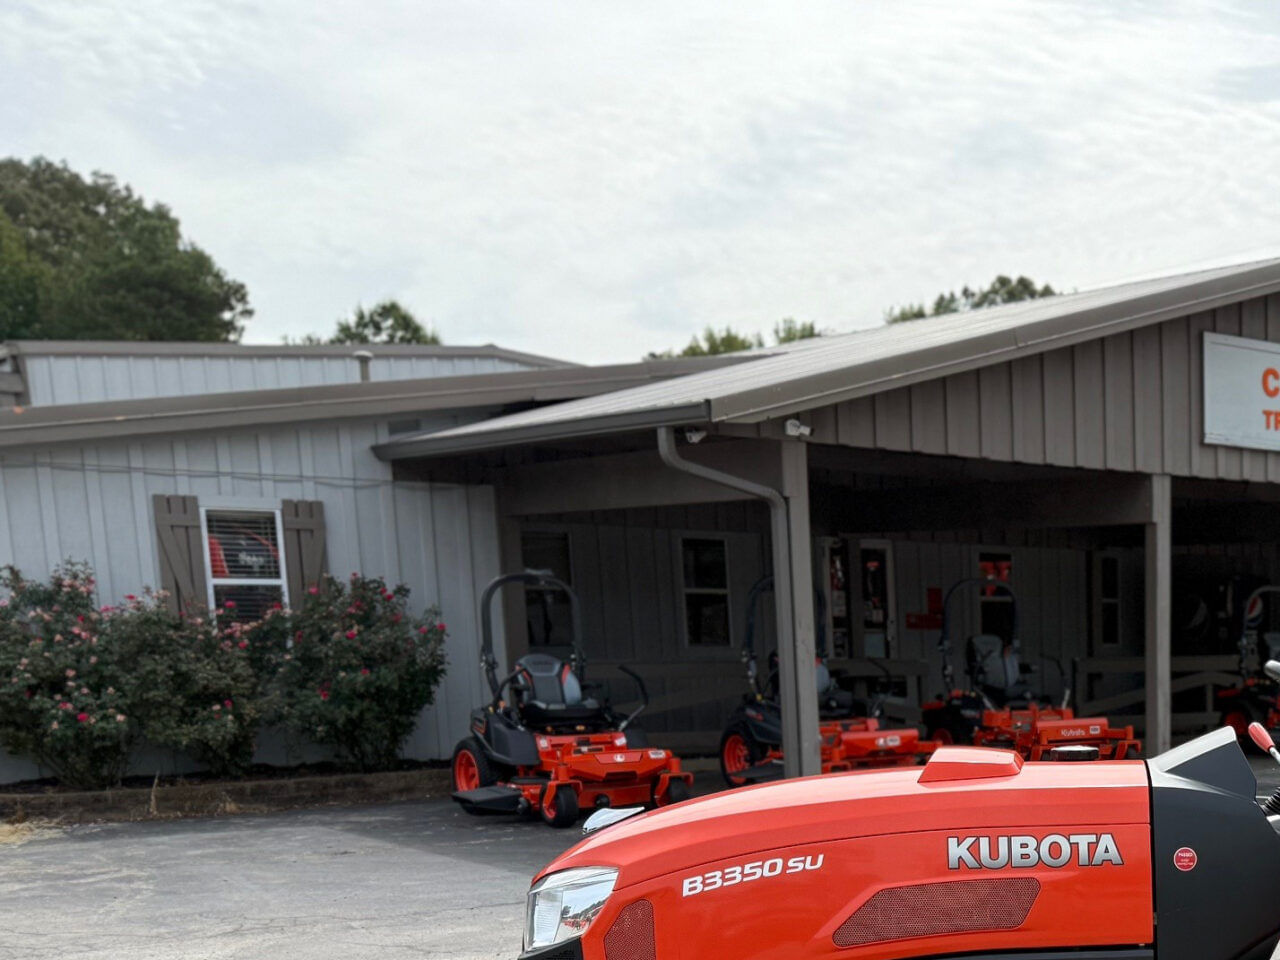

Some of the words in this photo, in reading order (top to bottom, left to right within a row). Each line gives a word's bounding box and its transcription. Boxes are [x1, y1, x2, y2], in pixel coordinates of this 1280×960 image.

[947, 833, 1124, 869] KUBOTA
[682, 858, 784, 897] B3350
[786, 853, 825, 874] SU
